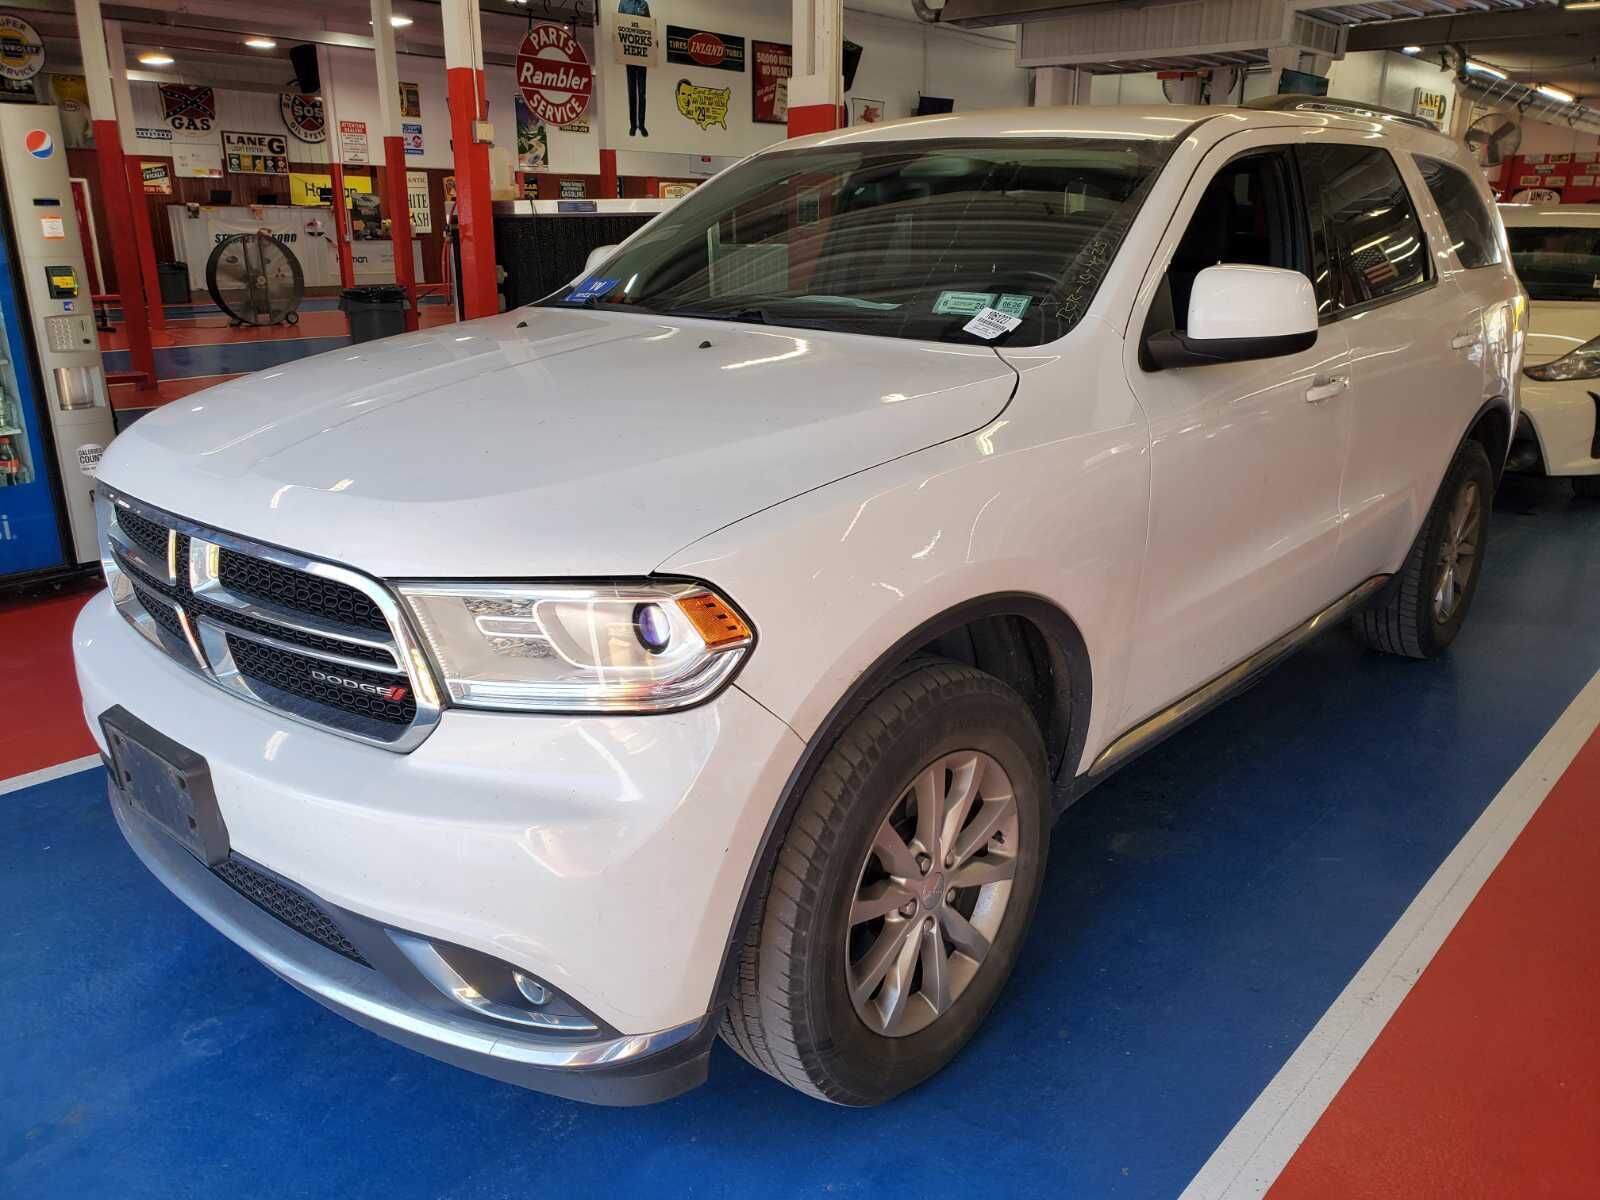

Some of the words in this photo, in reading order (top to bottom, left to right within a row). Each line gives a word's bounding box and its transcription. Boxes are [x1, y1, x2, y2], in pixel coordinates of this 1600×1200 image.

[0, 17, 29, 31] UPER
[530, 27, 577, 55] PARTS
[618, 32, 653, 47] WORKS
[623, 44, 648, 57] HERE
[691, 41, 724, 57] INLAND
[0, 64, 35, 76] ERVICE
[520, 61, 590, 90] Rambler
[294, 106, 324, 117] SOS
[529, 94, 583, 123] SERVICE
[1419, 91, 1440, 107] LANE
[1437, 95, 1447, 120] D
[171, 117, 212, 131] GAS
[303, 130, 327, 140] SYSTE
[226, 135, 267, 147] LANE
[268, 137, 286, 154] G
[407, 193, 429, 208] HITE
[1531, 191, 1553, 201] UMPS
[409, 212, 430, 227] ASH
[311, 670, 393, 698] DODGE
